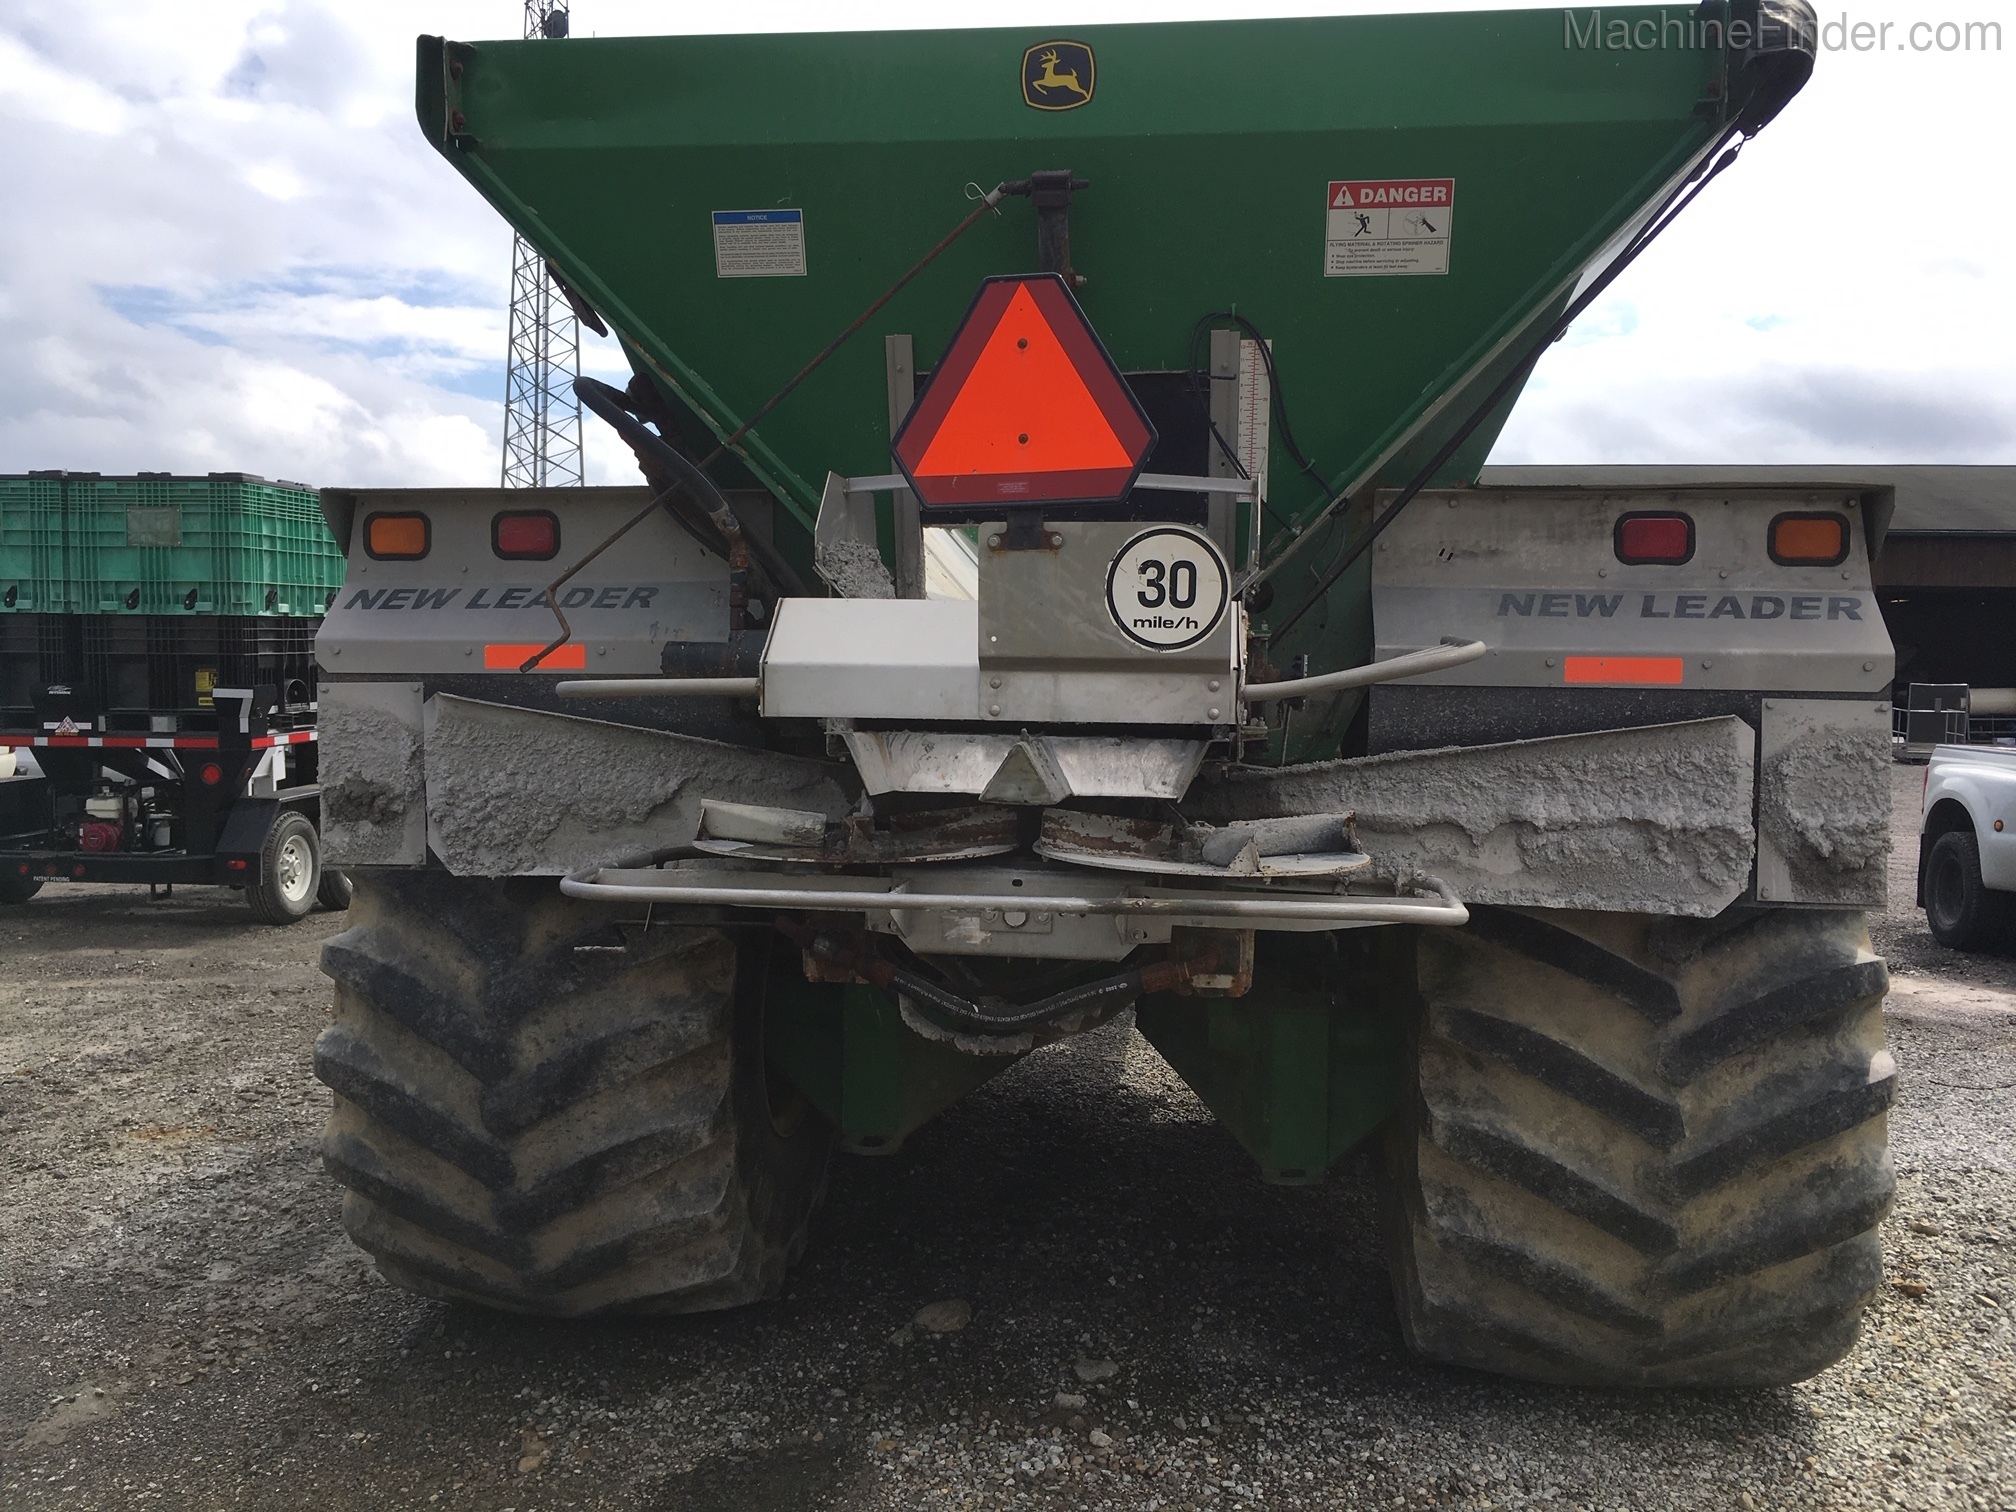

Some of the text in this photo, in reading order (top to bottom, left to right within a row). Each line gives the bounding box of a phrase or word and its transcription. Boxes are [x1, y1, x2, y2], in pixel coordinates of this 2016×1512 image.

[1360, 186, 1447, 204] DANGER
[1137, 559, 1197, 609] 30
[344, 586, 660, 610] NEW LEADER
[1497, 593, 1863, 621] NEW LEADER
[1133, 616, 1198, 629] mile/h
